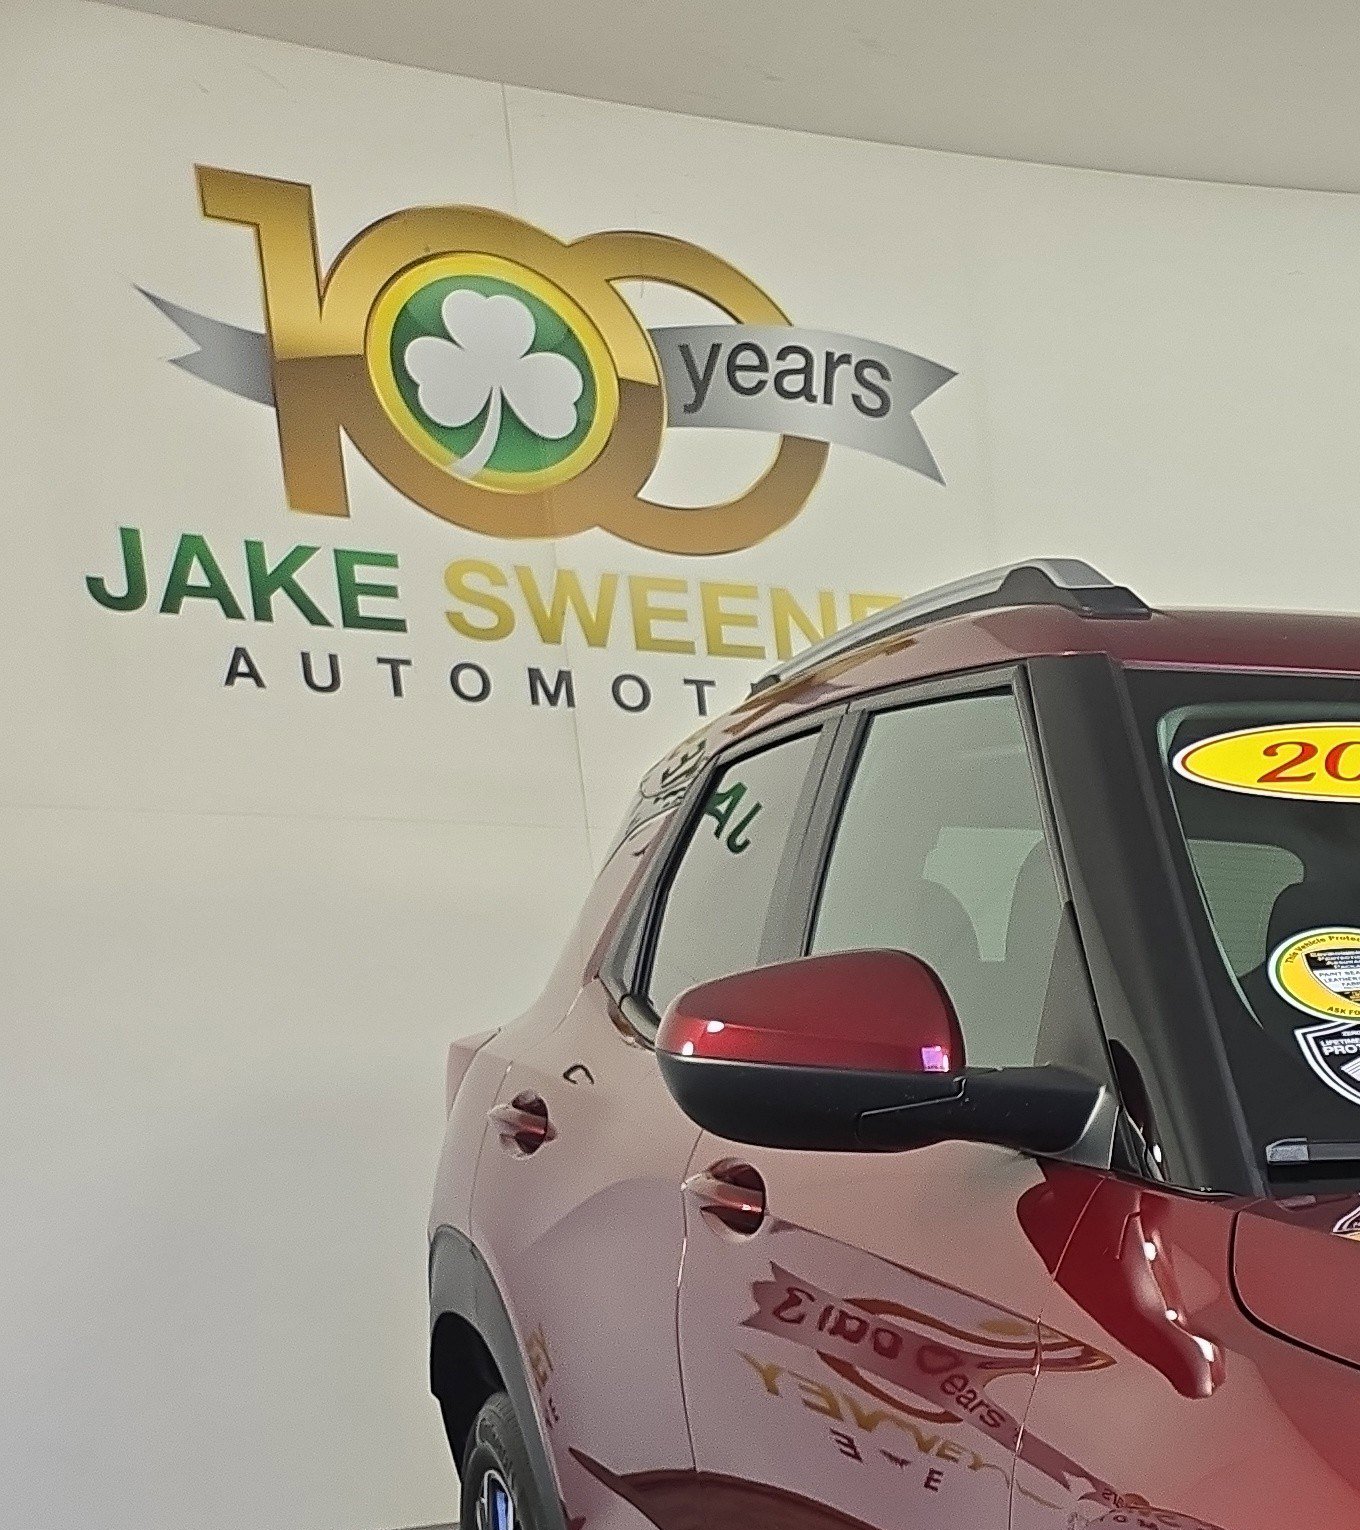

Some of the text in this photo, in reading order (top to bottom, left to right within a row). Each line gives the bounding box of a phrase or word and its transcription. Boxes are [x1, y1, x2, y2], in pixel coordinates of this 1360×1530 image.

[195, 163, 832, 556] 100
[677, 334, 893, 419] years
[85, 526, 408, 633] JAKE
[1320, 1037, 1360, 1047] LIFETIME
[1327, 1006, 1346, 1015] ASK
